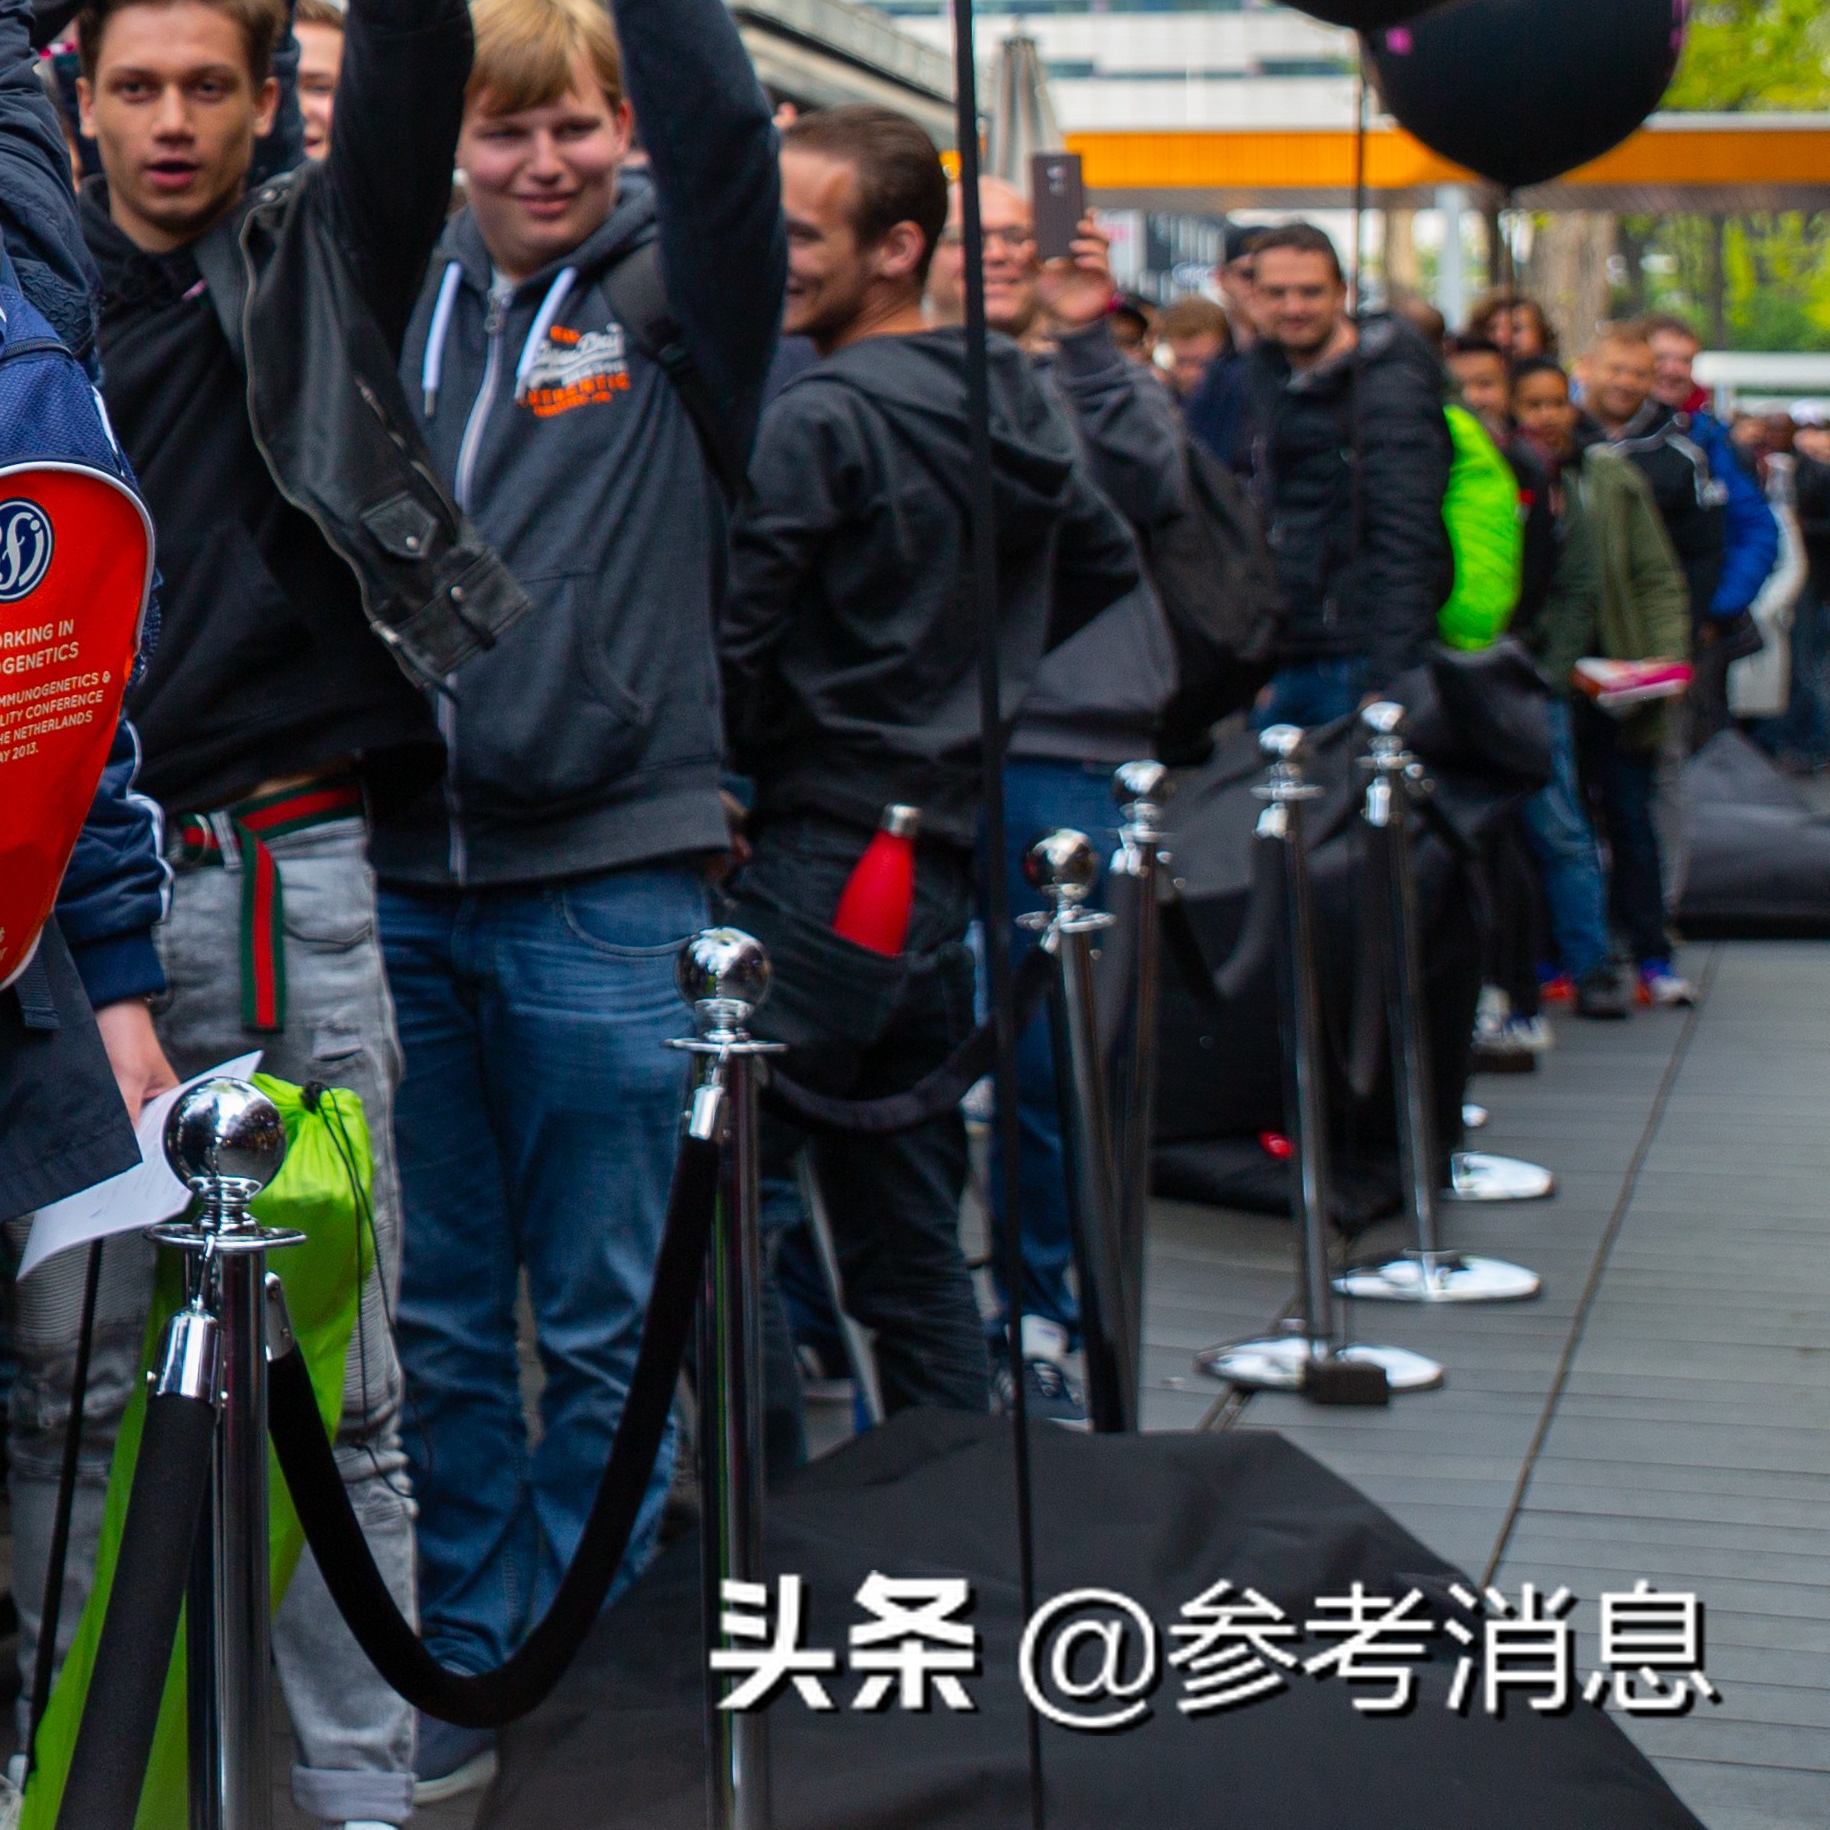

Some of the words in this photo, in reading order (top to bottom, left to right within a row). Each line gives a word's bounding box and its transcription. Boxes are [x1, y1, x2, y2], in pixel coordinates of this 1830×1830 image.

[58, 619, 75, 637] IN
[101, 670, 111, 684] &
[25, 689, 104, 720] CONFERENCE
[13, 710, 93, 741] NETHERLANDS
[12, 741, 39, 760] 2013.
